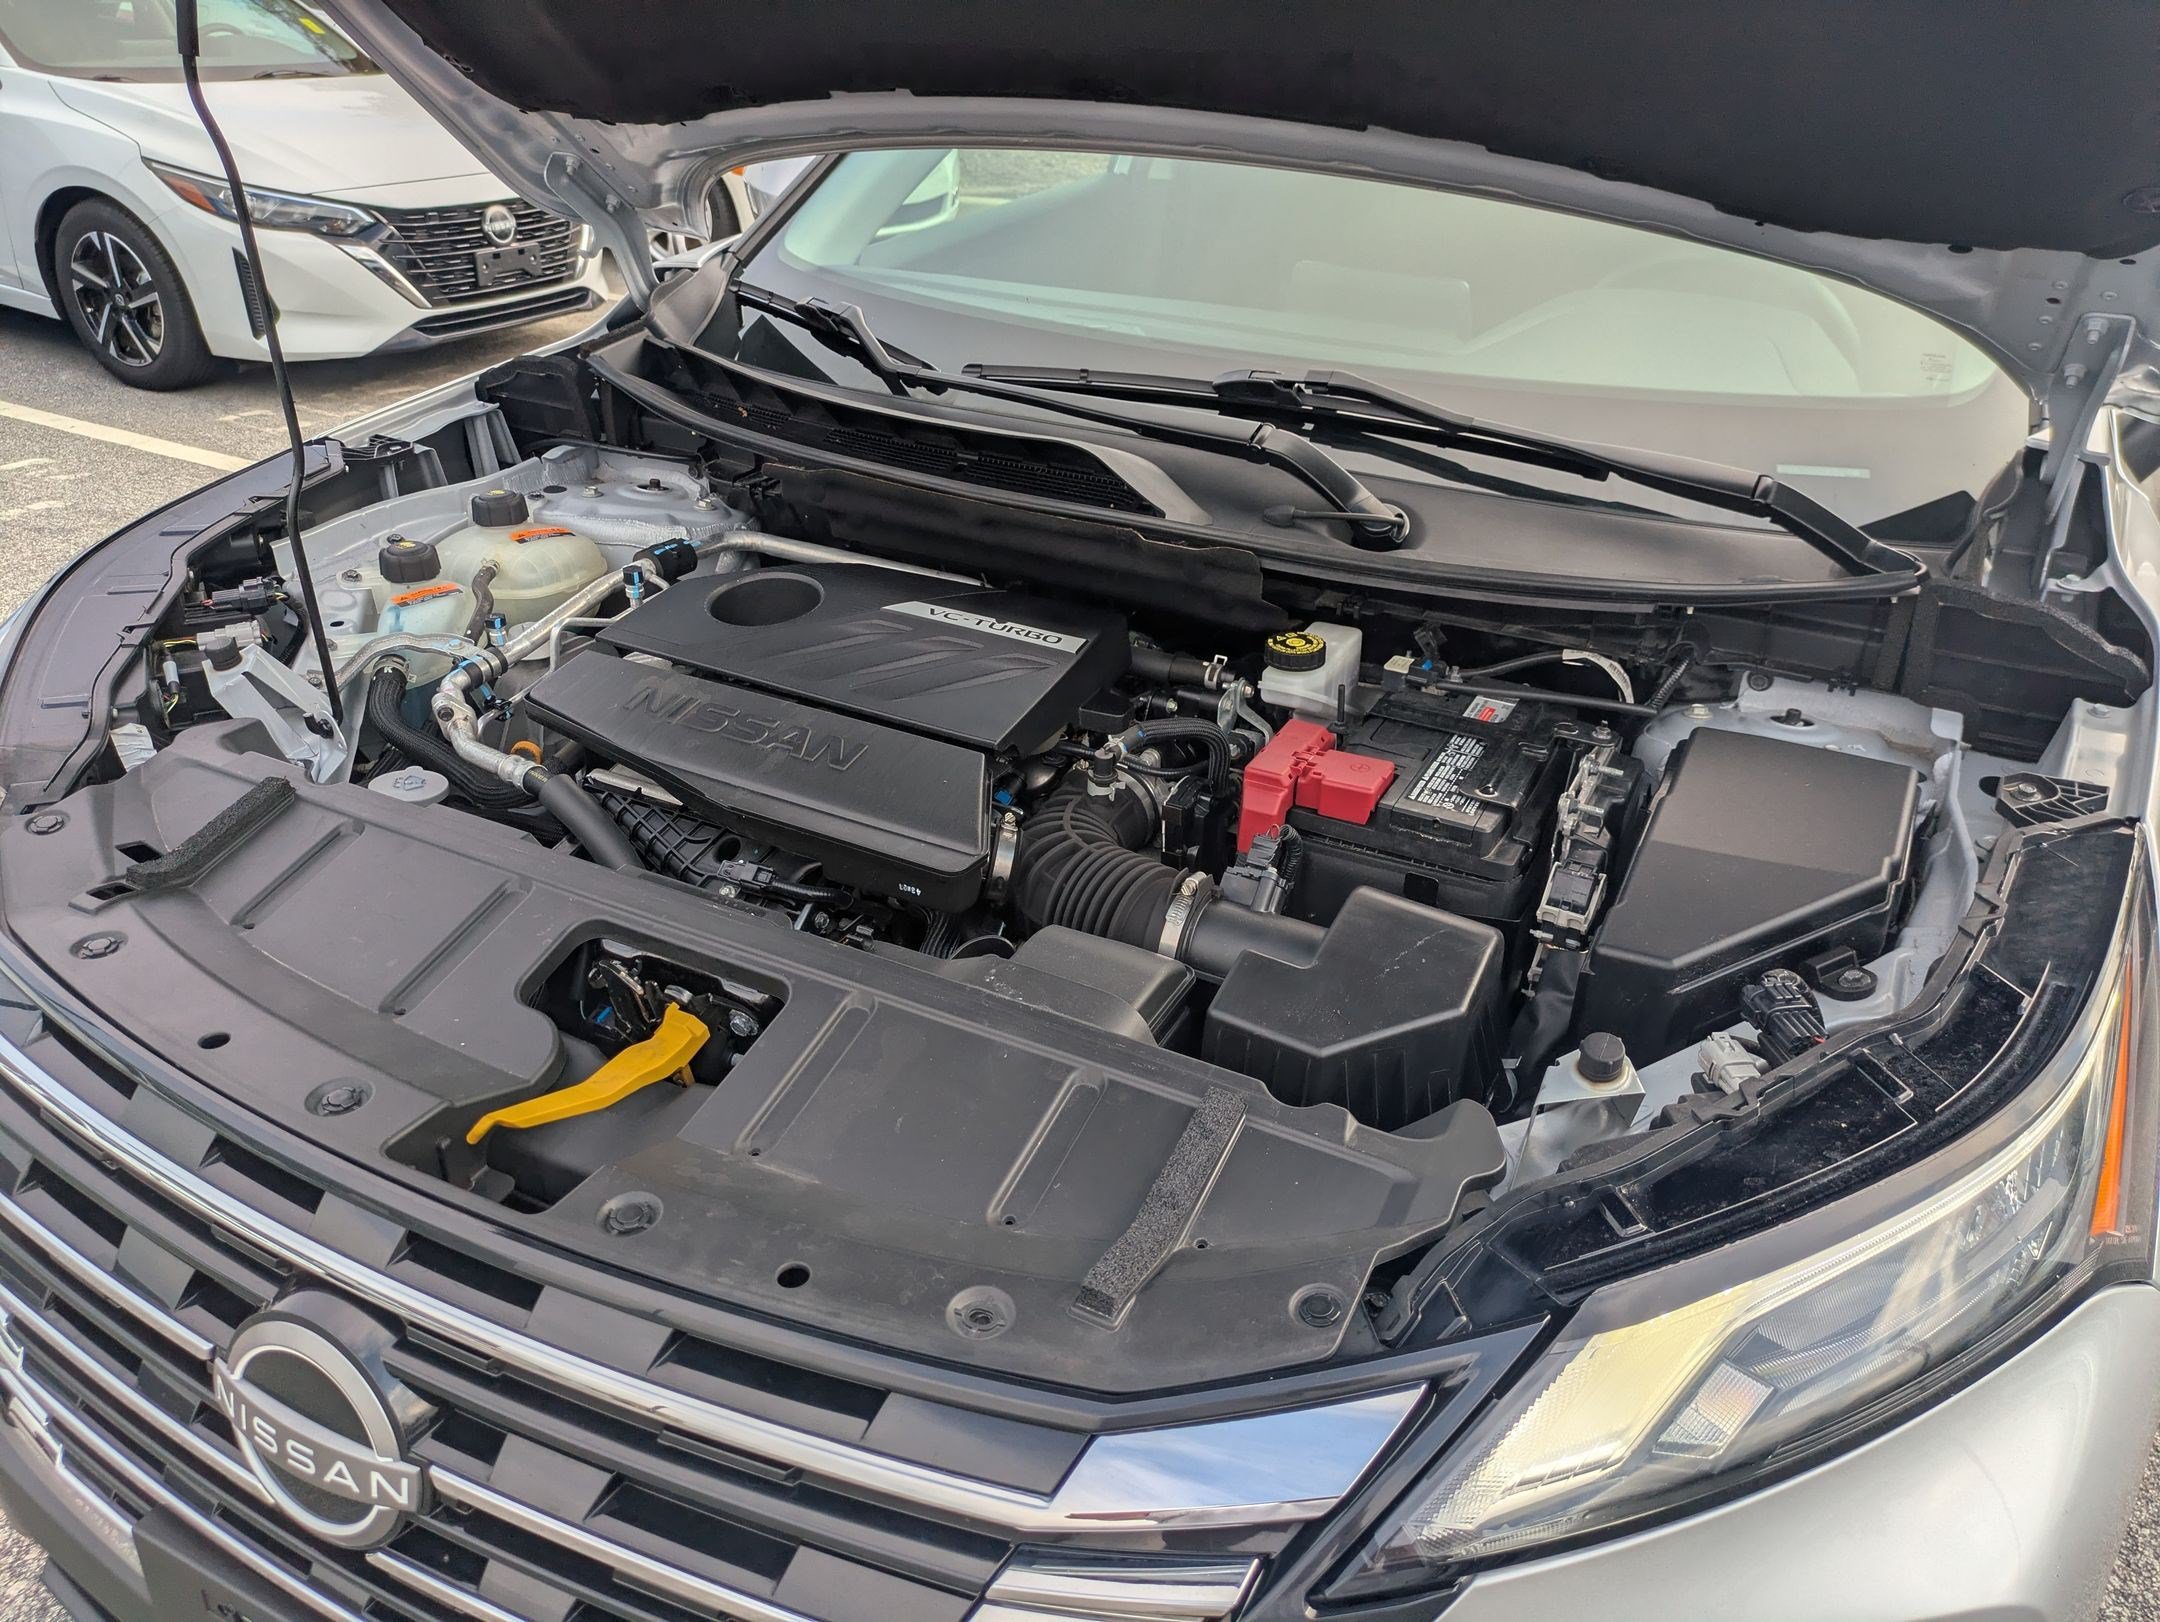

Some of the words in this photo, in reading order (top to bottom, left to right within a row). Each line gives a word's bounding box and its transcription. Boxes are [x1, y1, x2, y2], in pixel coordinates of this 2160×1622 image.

[928, 607, 1063, 645] VC-TURBO
[622, 687, 869, 771] NISSAN
[216, 1373, 409, 1506] NISSAN
